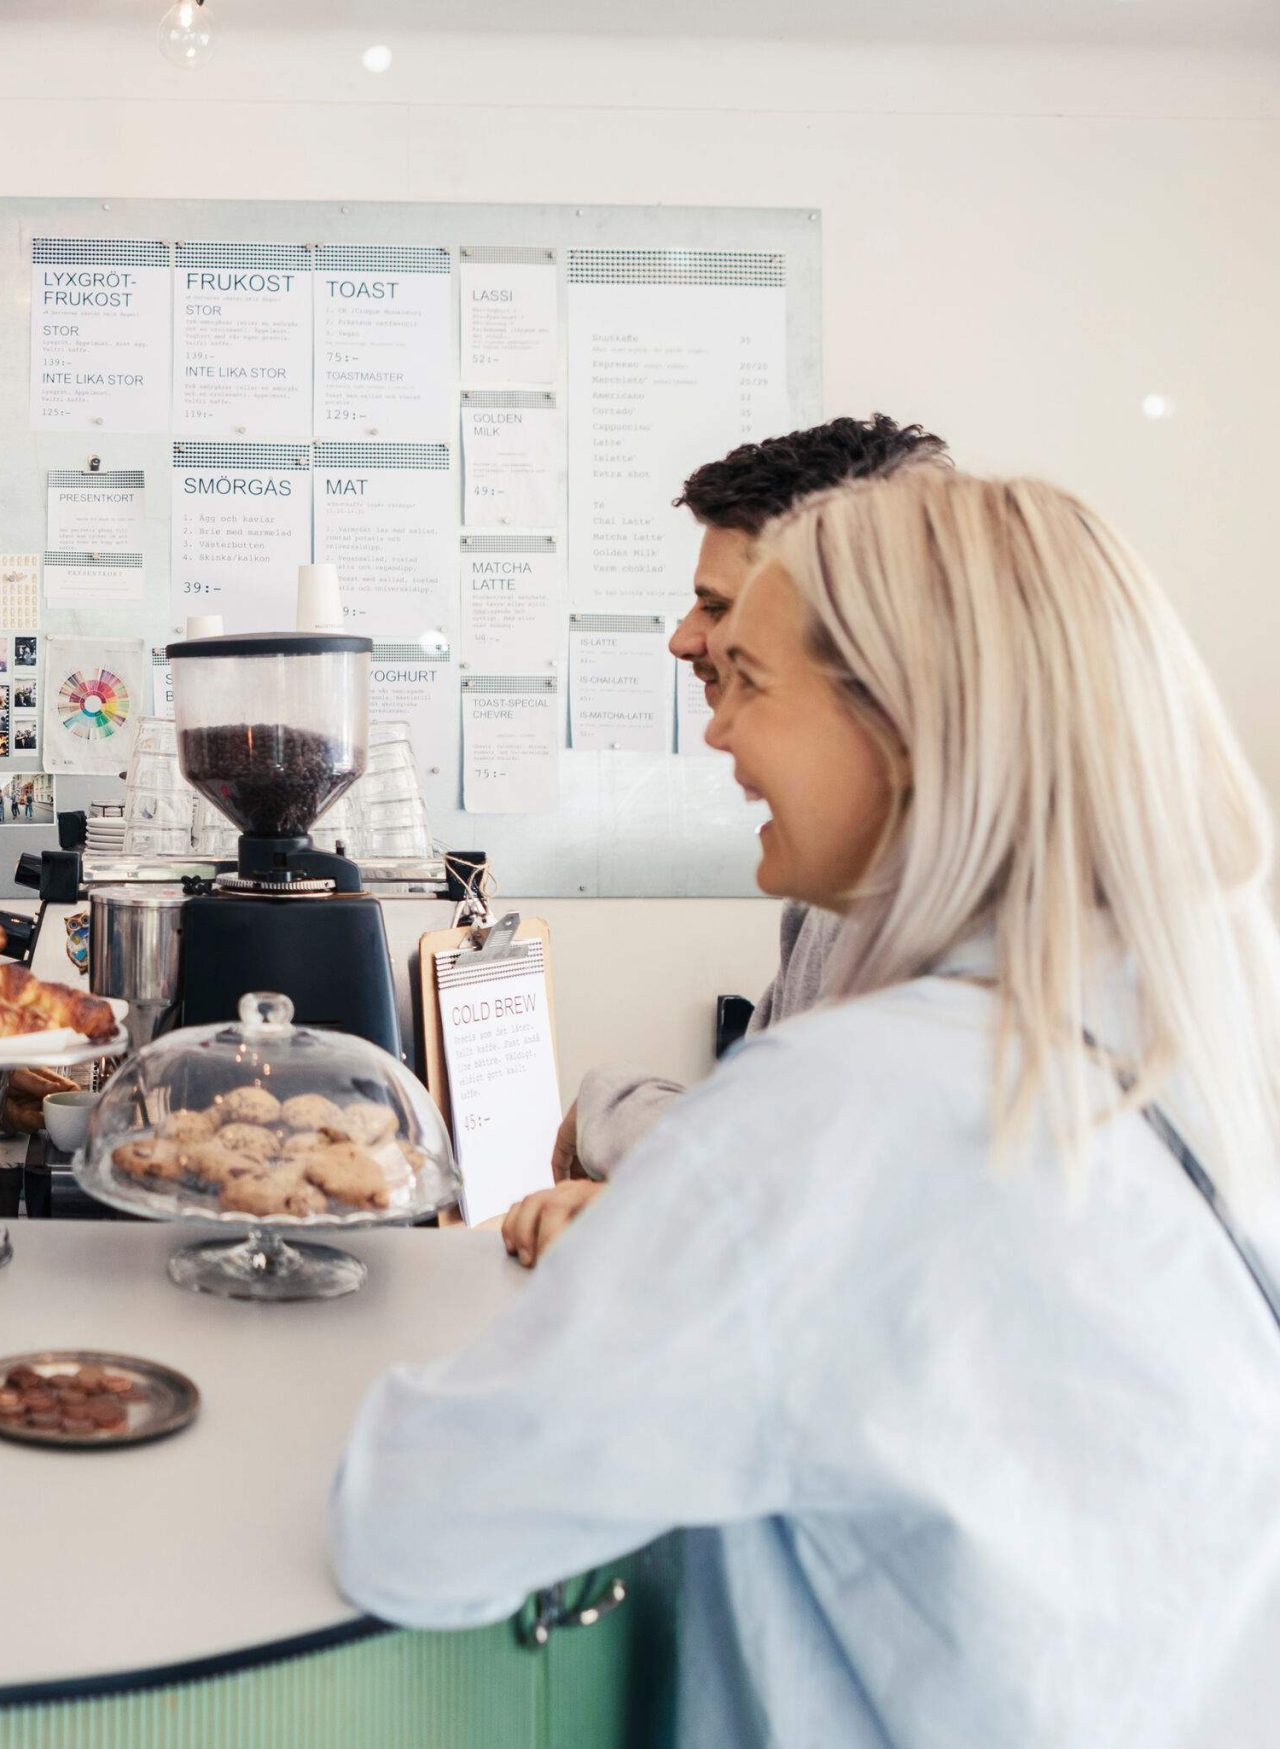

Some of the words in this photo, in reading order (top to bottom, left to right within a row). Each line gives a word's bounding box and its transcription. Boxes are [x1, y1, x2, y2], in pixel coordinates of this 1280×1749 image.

[43, 270, 137, 288] LYXGRÖT-
[186, 273, 295, 293] FRUKOST
[325, 280, 400, 299] TOAST
[43, 291, 134, 307] FRUKOST
[472, 290, 514, 302] LASSI
[185, 305, 222, 316] STOR
[42, 325, 80, 337] STOR
[326, 351, 360, 364] 75:-
[185, 366, 217, 378] INTE
[219, 366, 248, 378] LIKA
[250, 367, 287, 379] STOR
[325, 371, 406, 383] TOASTMASTER
[42, 373, 72, 384] INTE
[75, 373, 105, 385] LIKA
[107, 374, 144, 386] STOR
[326, 409, 368, 421] 129:-
[473, 413, 523, 424] GOLDEN
[473, 426, 501, 437] MILK
[325, 479, 370, 496] MAT
[59, 493, 136, 503] PRESENTKORT
[220, 514, 237, 522] och
[472, 562, 533, 574] MATCHA
[183, 581, 222, 594] 39:-
[472, 578, 516, 591] LATTE
[580, 638, 618, 647] IS-LATTE
[579, 674, 639, 686] IS-CHAI-LATTE
[472, 698, 551, 709] TOAST-SPECIAL
[579, 711, 655, 721] IS-MATCHA-LATTE
[452, 1001, 490, 1026] COLD
[495, 993, 536, 1018] BREW
